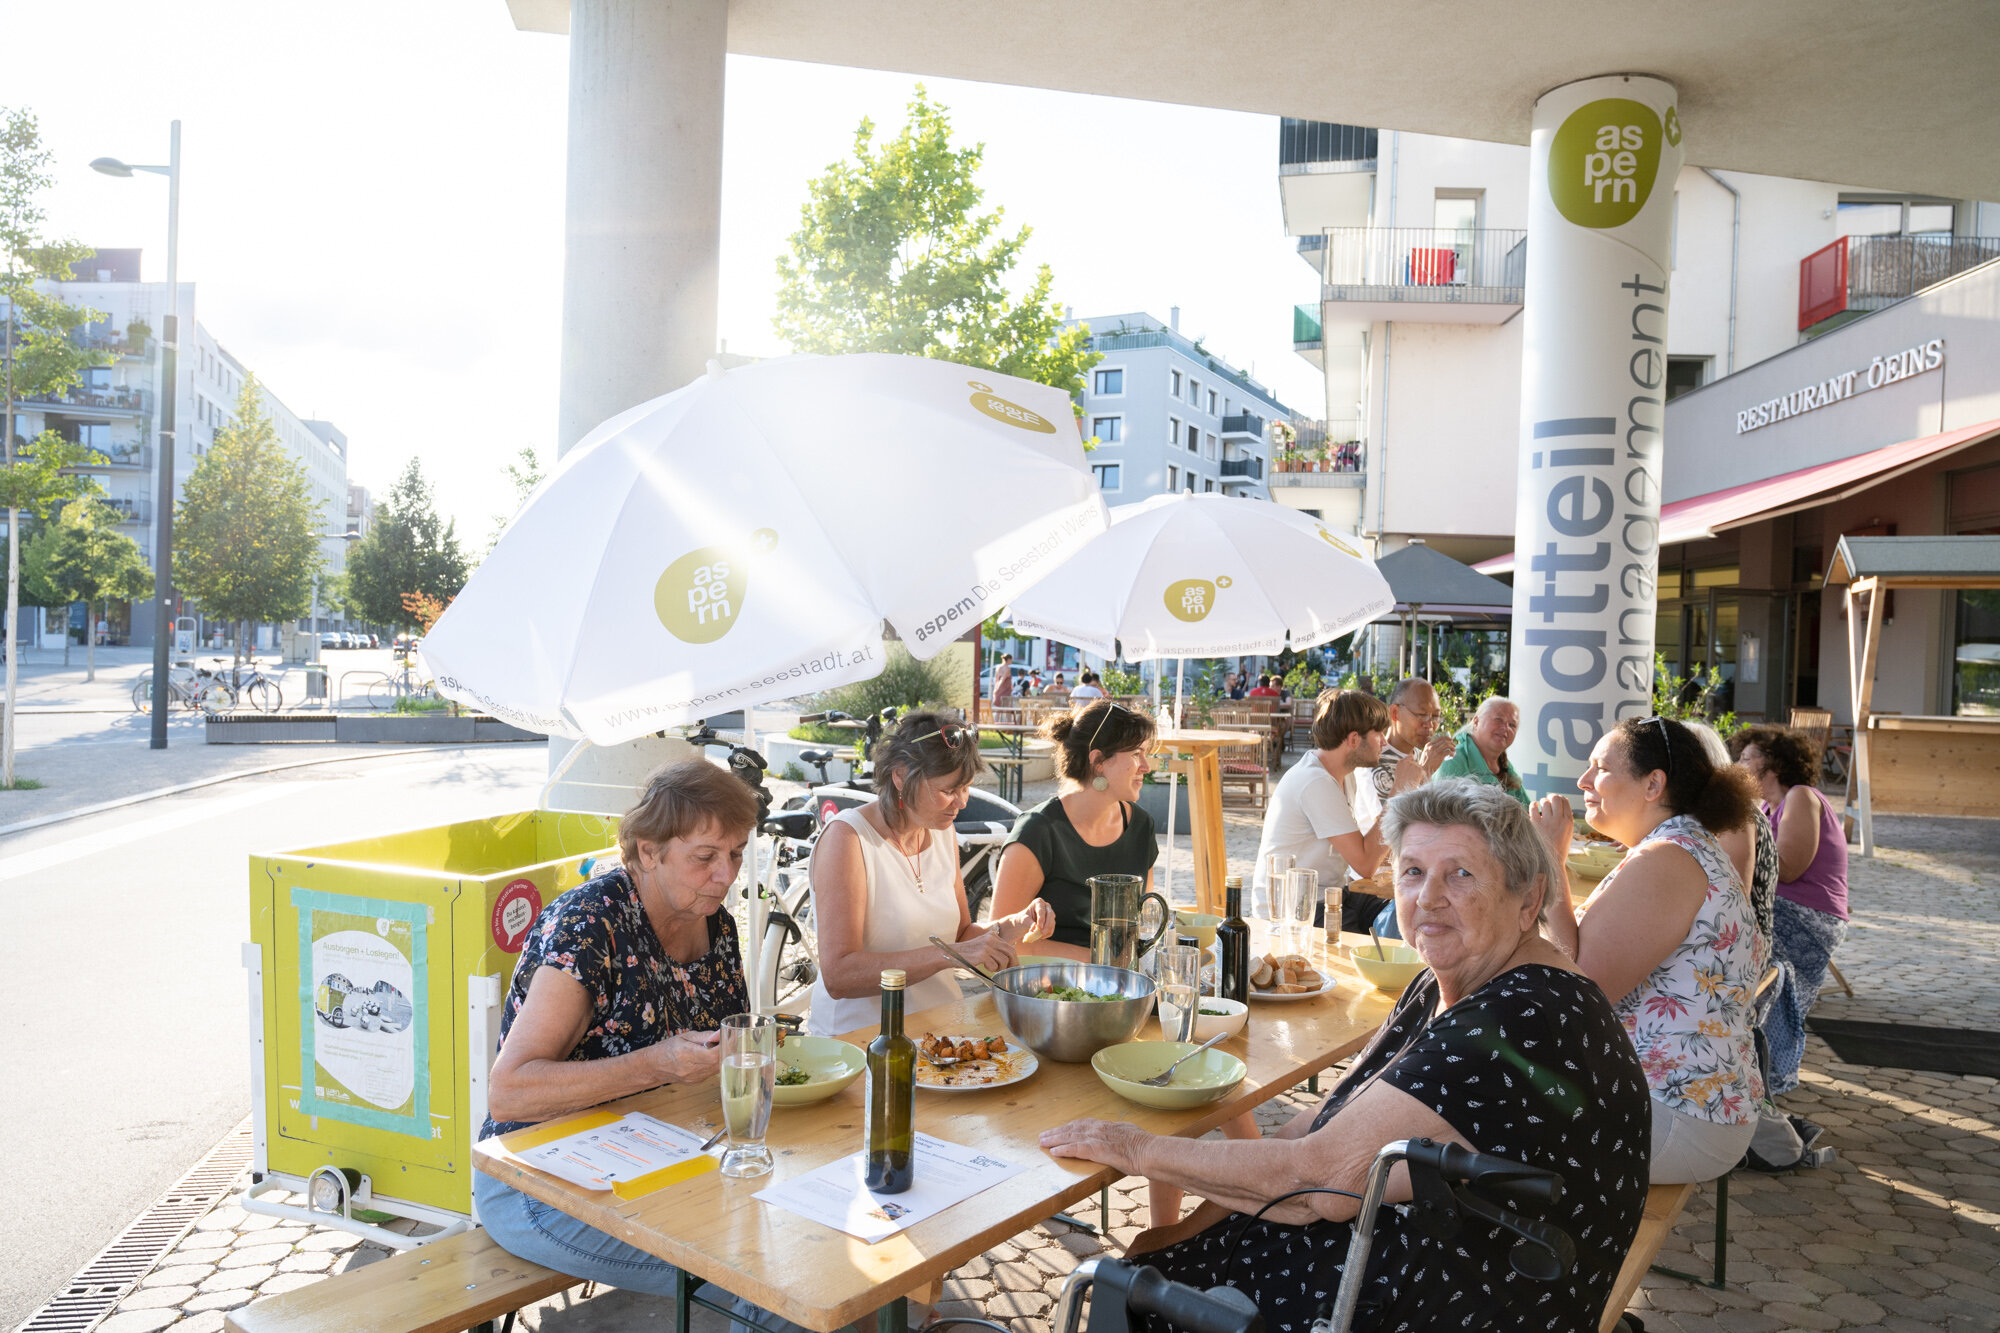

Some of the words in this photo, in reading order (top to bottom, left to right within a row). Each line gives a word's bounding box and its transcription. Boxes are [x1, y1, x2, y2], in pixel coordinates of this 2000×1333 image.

[1595, 124, 1644, 151] as
[1584, 150, 1638, 187] pe
[1593, 177, 1637, 204] rn
[1736, 370, 1858, 435] RESTAURANT
[1867, 339, 1944, 389] ÖEINS
[692, 560, 731, 586] as
[914, 596, 976, 642] aspern
[971, 579, 1001, 601] Die
[998, 529, 1064, 582] Seestadt
[687, 580, 728, 614] pe
[1181, 595, 1205, 608] pe
[1184, 586, 1206, 597] as
[697, 599, 731, 625] rn
[1186, 604, 1206, 615] rn
[1521, 416, 1617, 815] tadtteil
[604, 644, 875, 729] www.aspern-seestadt.at
